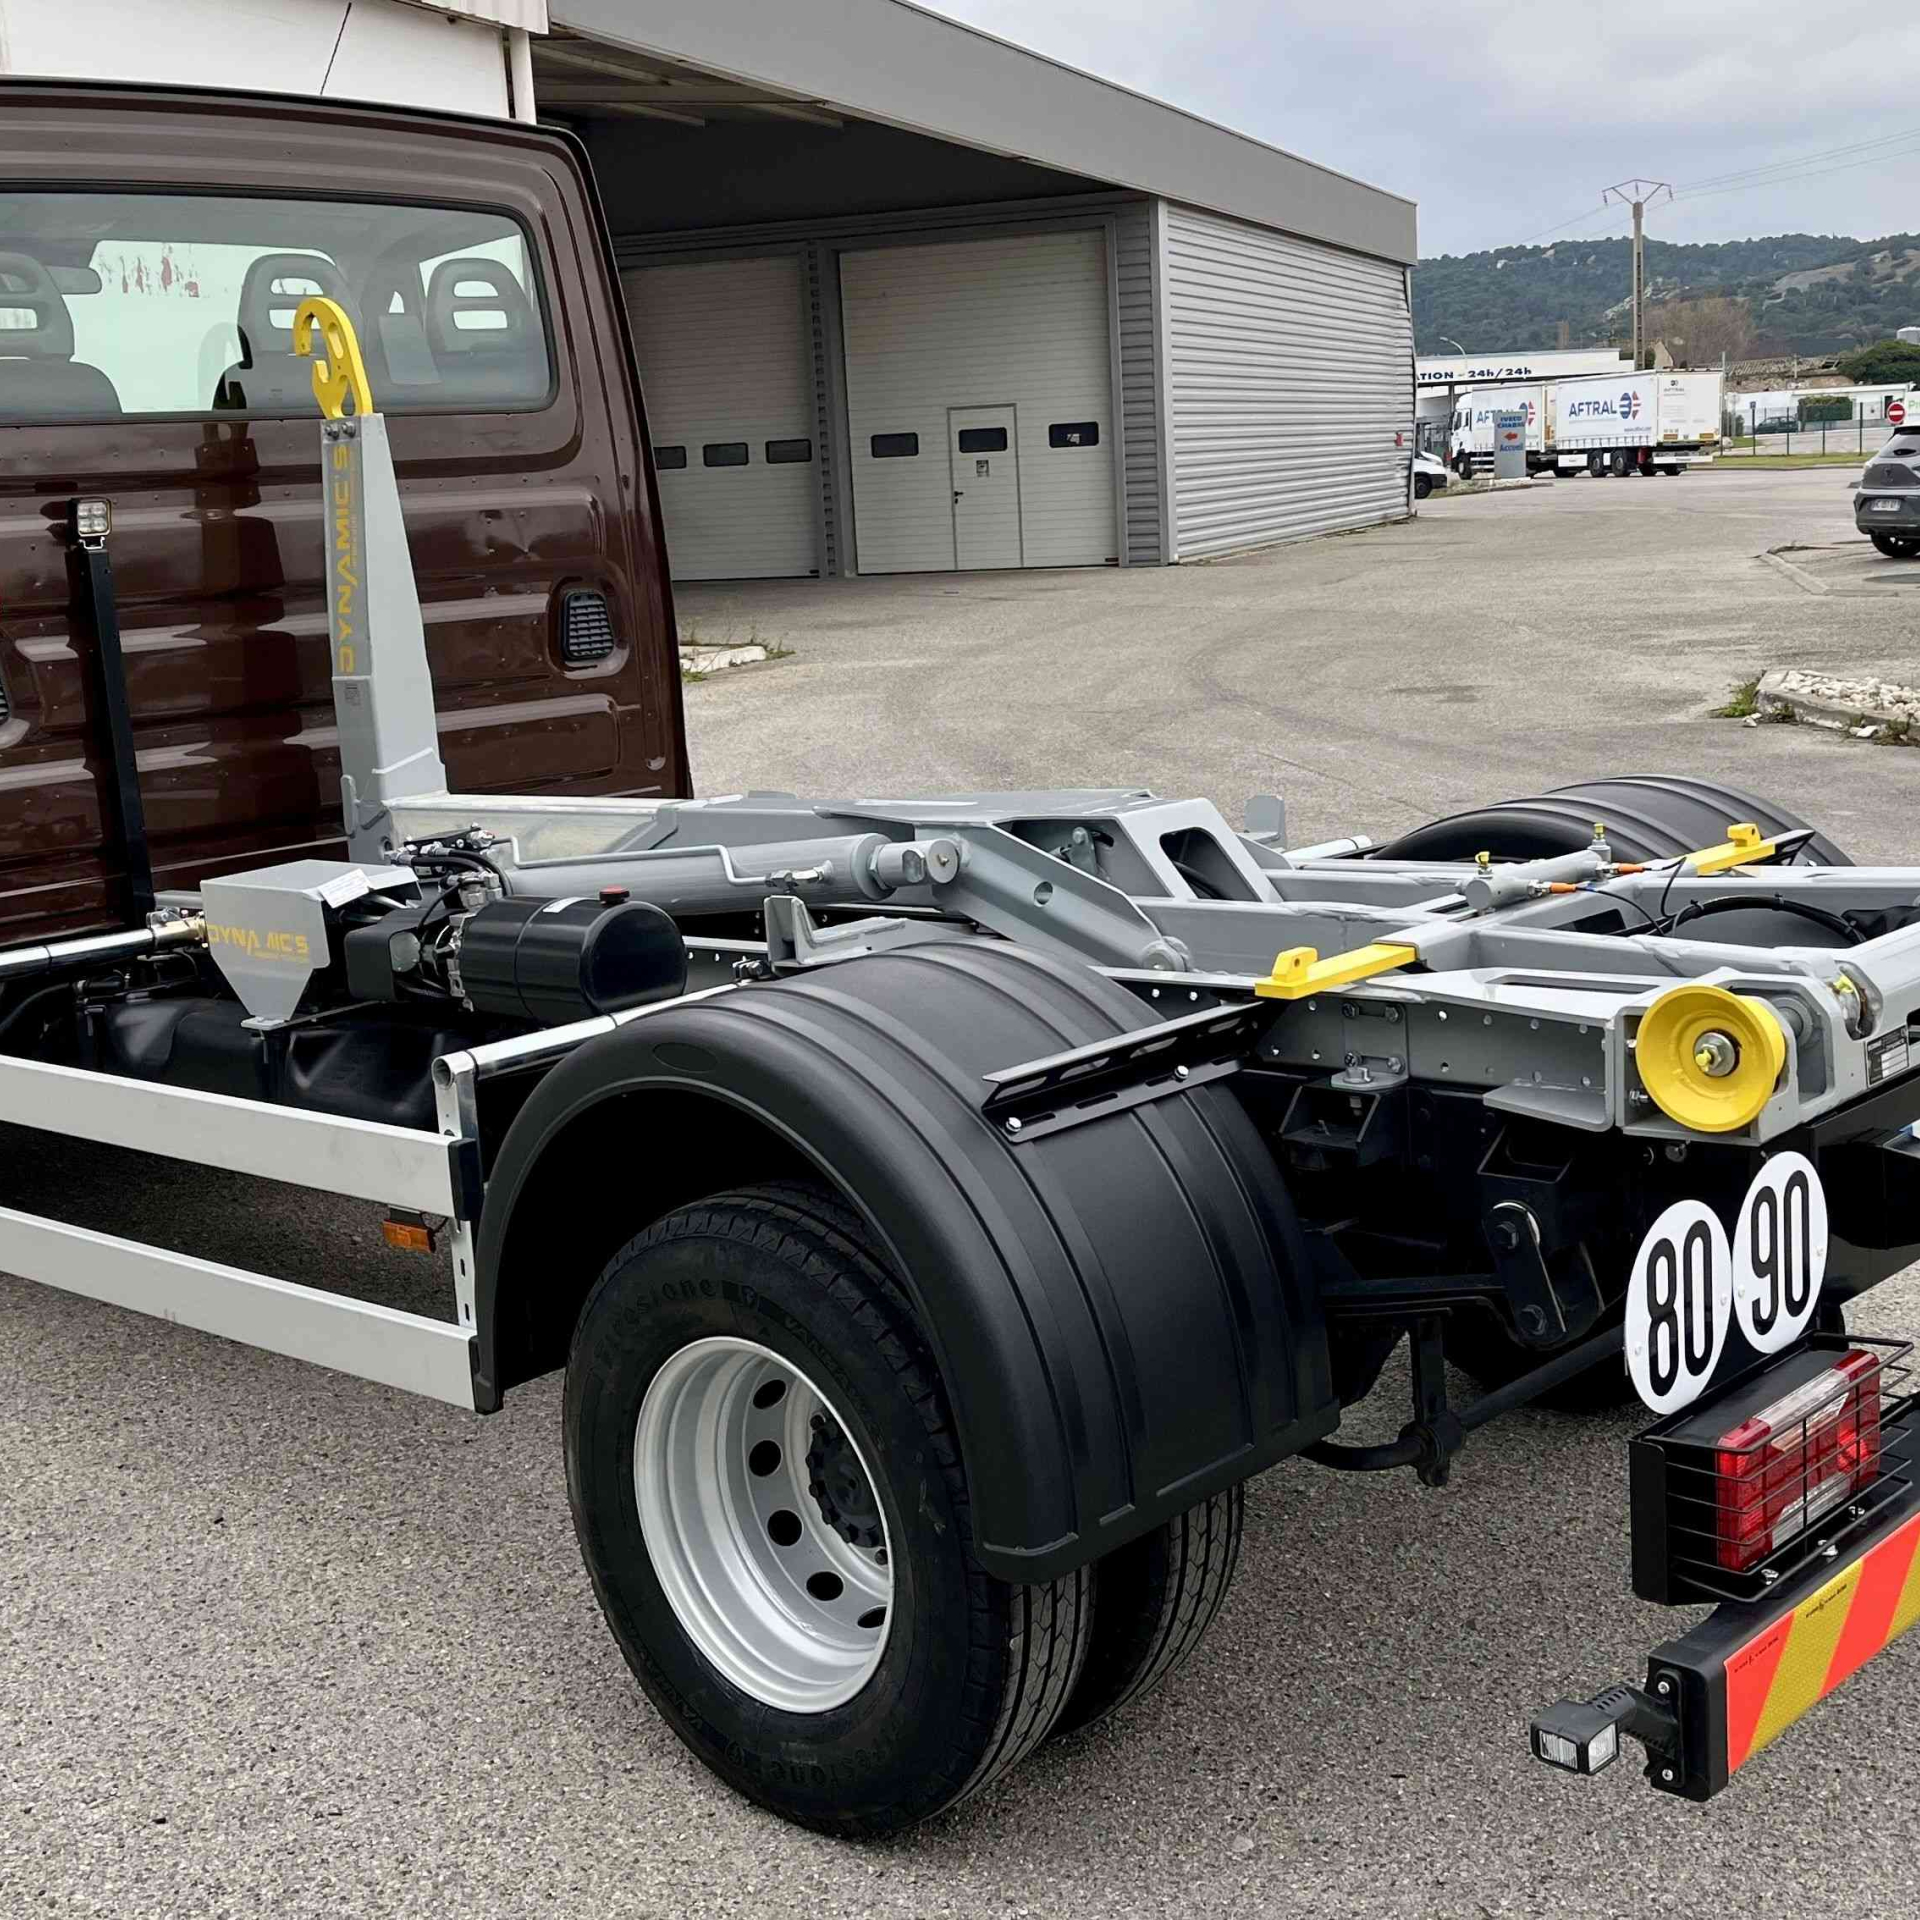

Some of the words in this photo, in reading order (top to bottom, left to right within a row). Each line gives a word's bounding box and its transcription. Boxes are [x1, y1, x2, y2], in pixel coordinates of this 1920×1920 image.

[1416, 371, 1454, 381] TION
[1569, 400, 1617, 417] AFTRAL
[1751, 1170, 1810, 1336] 90
[1646, 1219, 1713, 1397] 80
